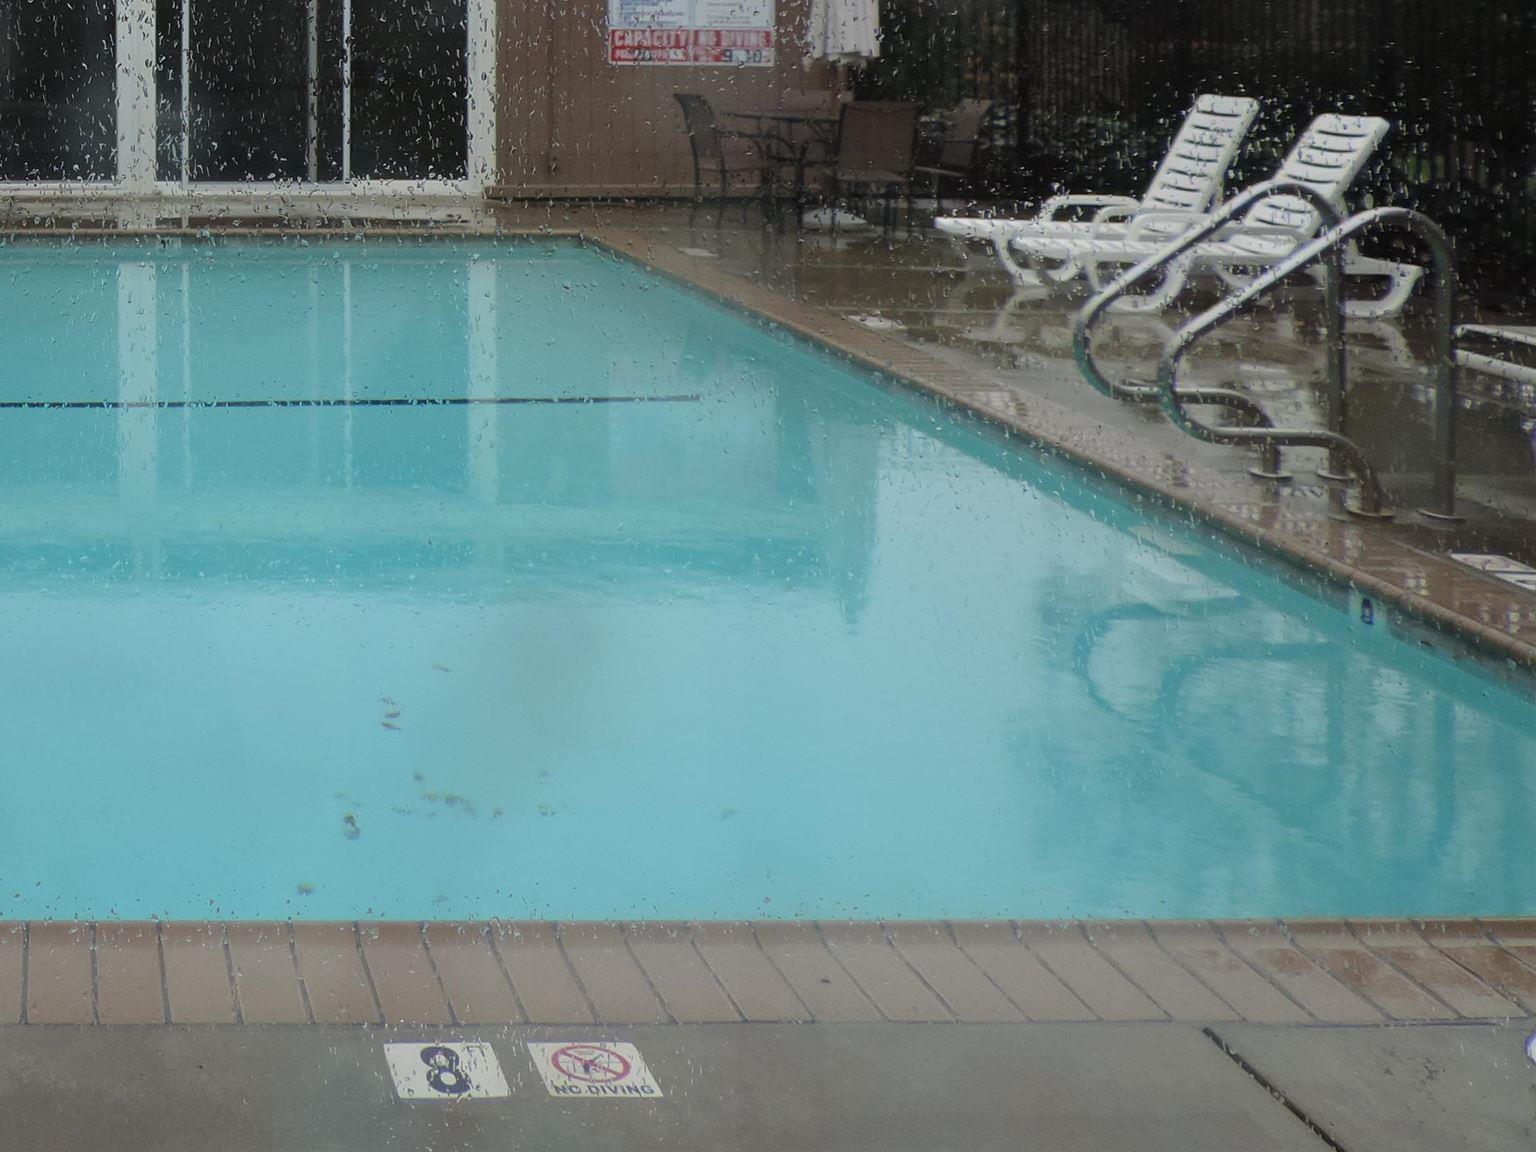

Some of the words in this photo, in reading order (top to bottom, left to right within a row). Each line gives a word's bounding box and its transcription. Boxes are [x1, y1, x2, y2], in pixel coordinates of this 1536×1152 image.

[614, 29, 688, 47] CAPACITY
[420, 1046, 472, 1094] 8
[553, 1084, 582, 1095] NO
[588, 1084, 654, 1095] DIVING
